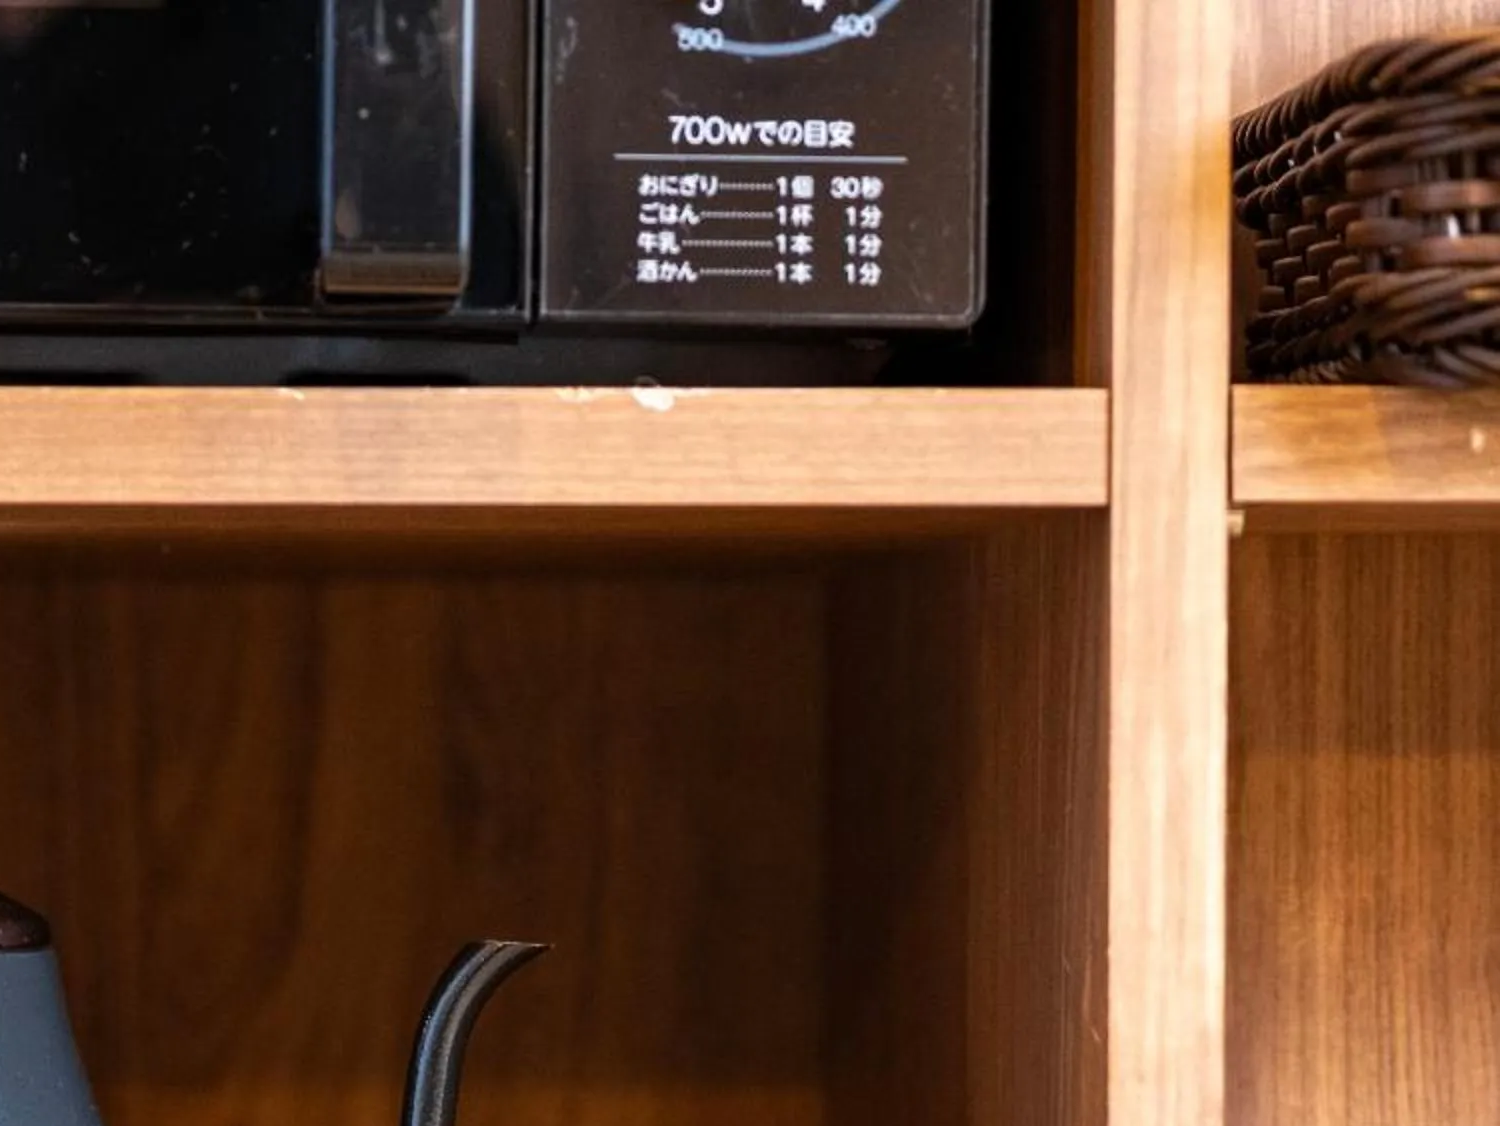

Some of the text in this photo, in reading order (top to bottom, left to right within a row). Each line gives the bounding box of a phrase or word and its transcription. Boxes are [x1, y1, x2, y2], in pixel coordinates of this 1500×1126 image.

[831, 14, 876, 38] 400
[638, 174, 883, 199] おにぎり 1個 30秒
[638, 202, 700, 225] ごはん
[845, 204, 883, 229] 1分
[637, 231, 883, 257] 牛乳 1本 1分
[637, 259, 882, 286] 酒かん 1本 1分
